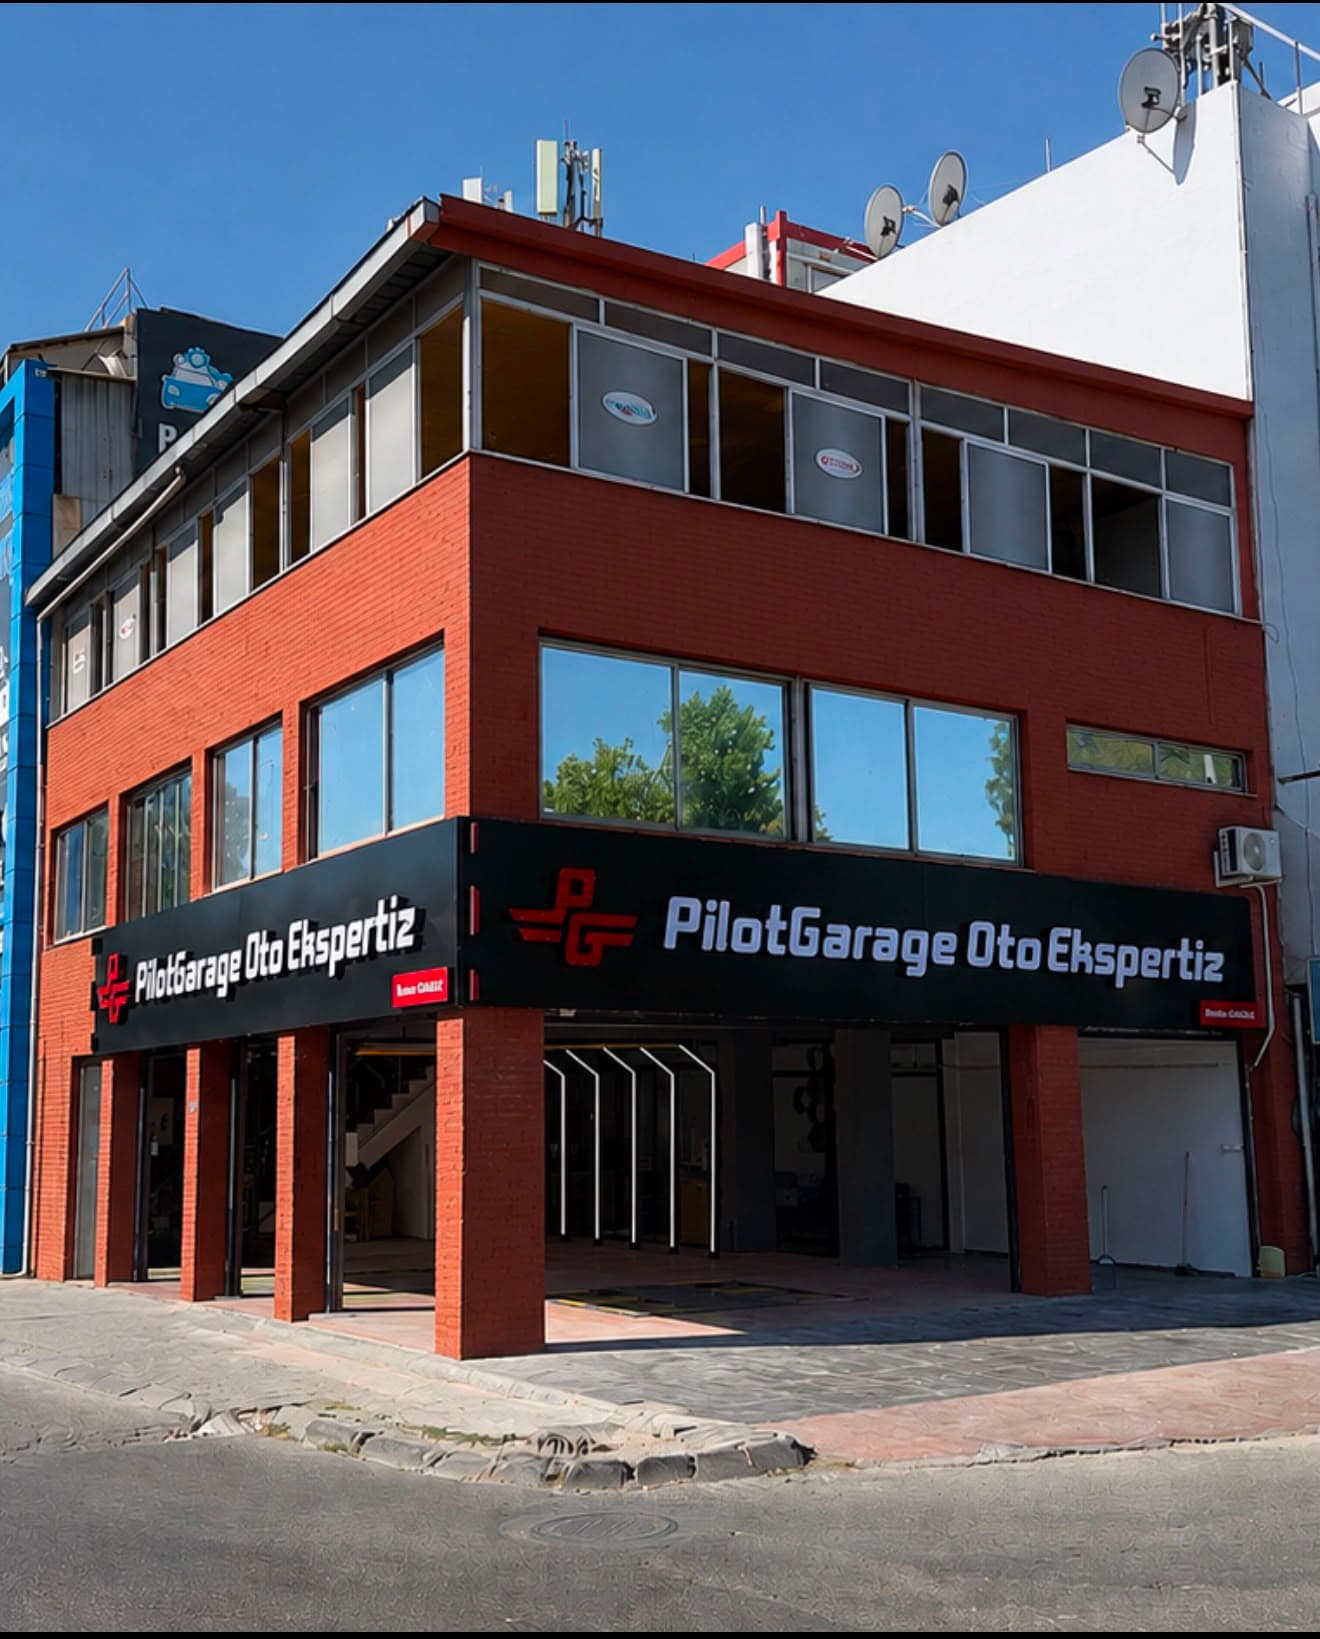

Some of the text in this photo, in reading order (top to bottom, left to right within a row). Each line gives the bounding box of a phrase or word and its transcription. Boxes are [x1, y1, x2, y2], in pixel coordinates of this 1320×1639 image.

[134, 894, 416, 1003] PilotGarage Oto Ekspertiz
[664, 896, 1224, 988] PilotGarage Oto Ekspertiz
